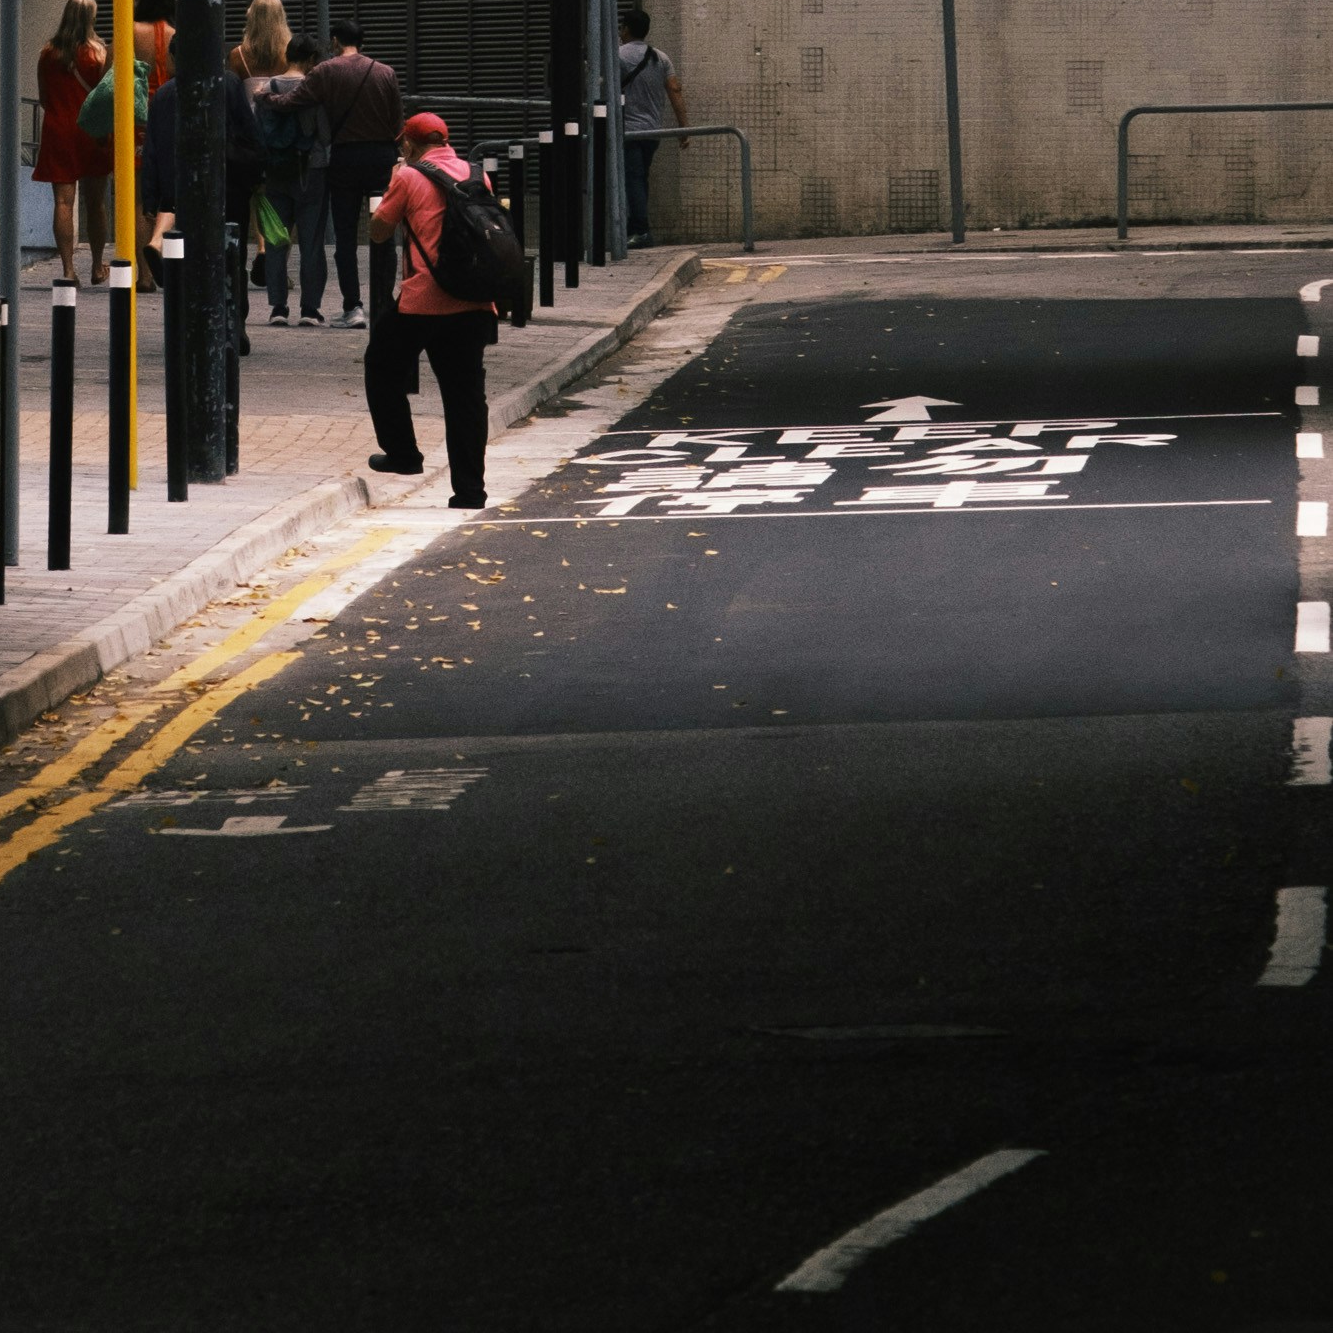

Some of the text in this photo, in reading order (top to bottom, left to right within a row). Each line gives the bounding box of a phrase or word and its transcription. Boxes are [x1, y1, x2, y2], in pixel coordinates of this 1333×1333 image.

[571, 434, 1178, 465] CLEAR
[645, 421, 1119, 448] KEEP
[594, 454, 1092, 492] 請勿
[574, 480, 1070, 517] 停車
